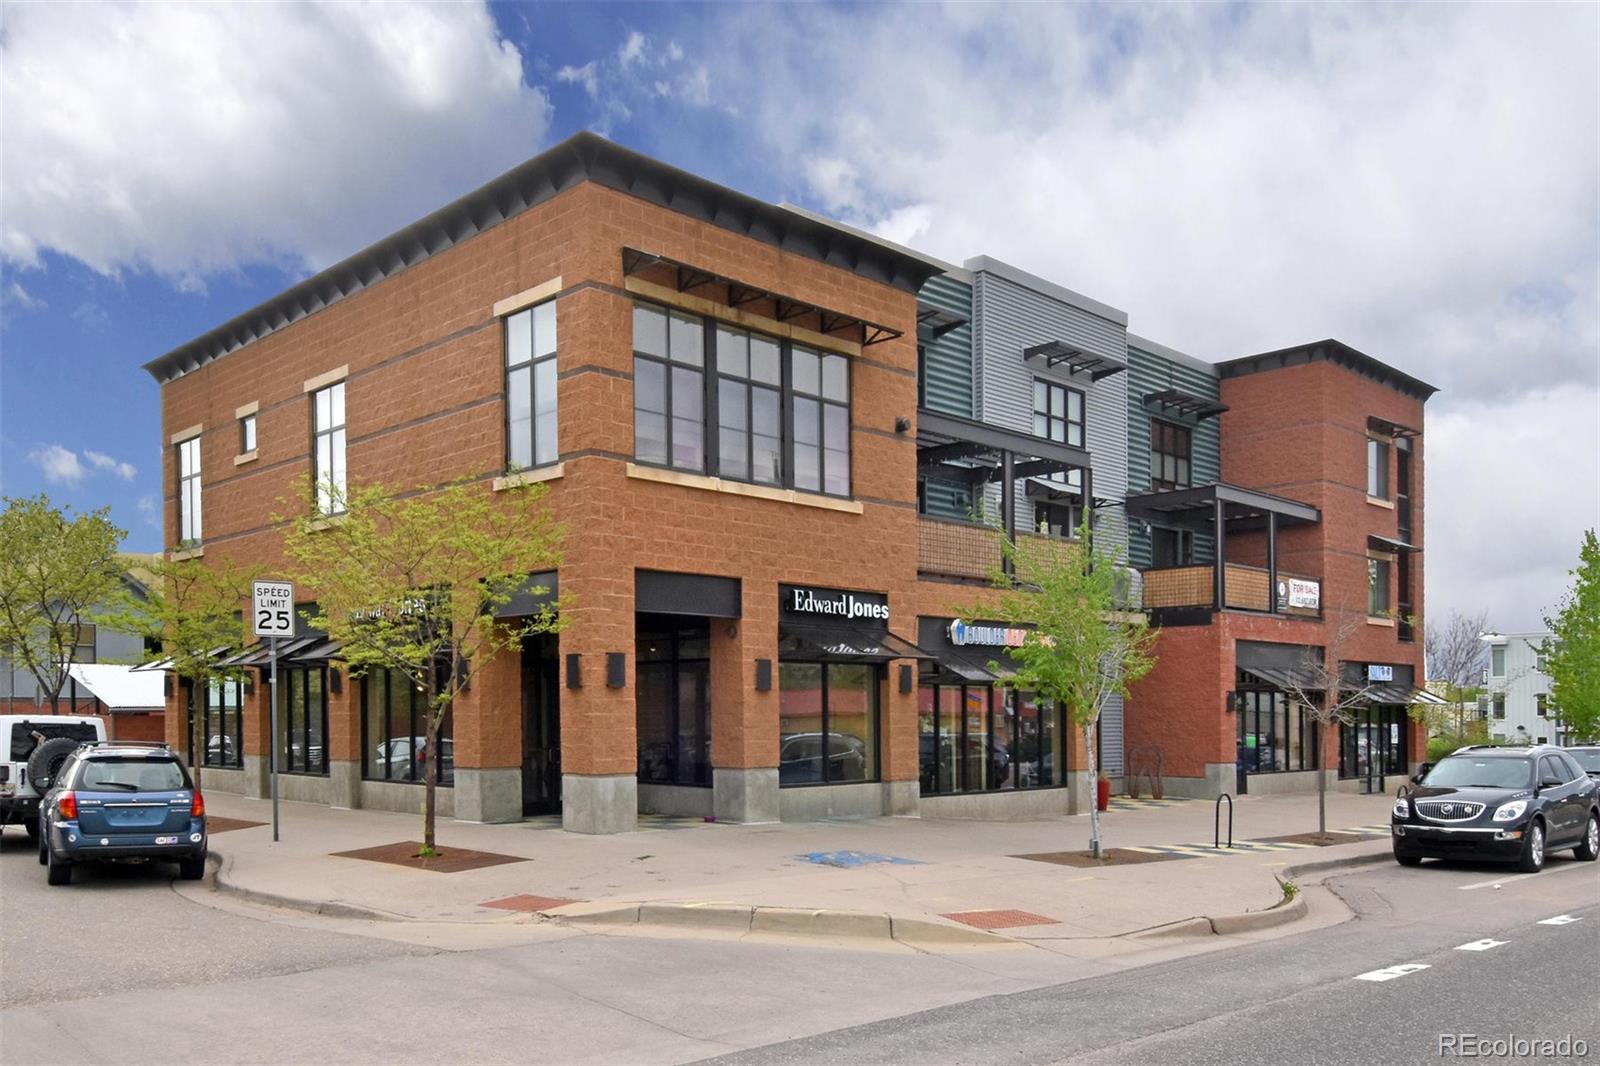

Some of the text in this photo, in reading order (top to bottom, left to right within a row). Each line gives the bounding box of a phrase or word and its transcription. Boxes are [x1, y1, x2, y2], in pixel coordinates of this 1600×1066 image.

[256, 587, 290, 598] SPEED
[260, 599, 287, 608] LIMIT
[258, 610, 290, 630] 25
